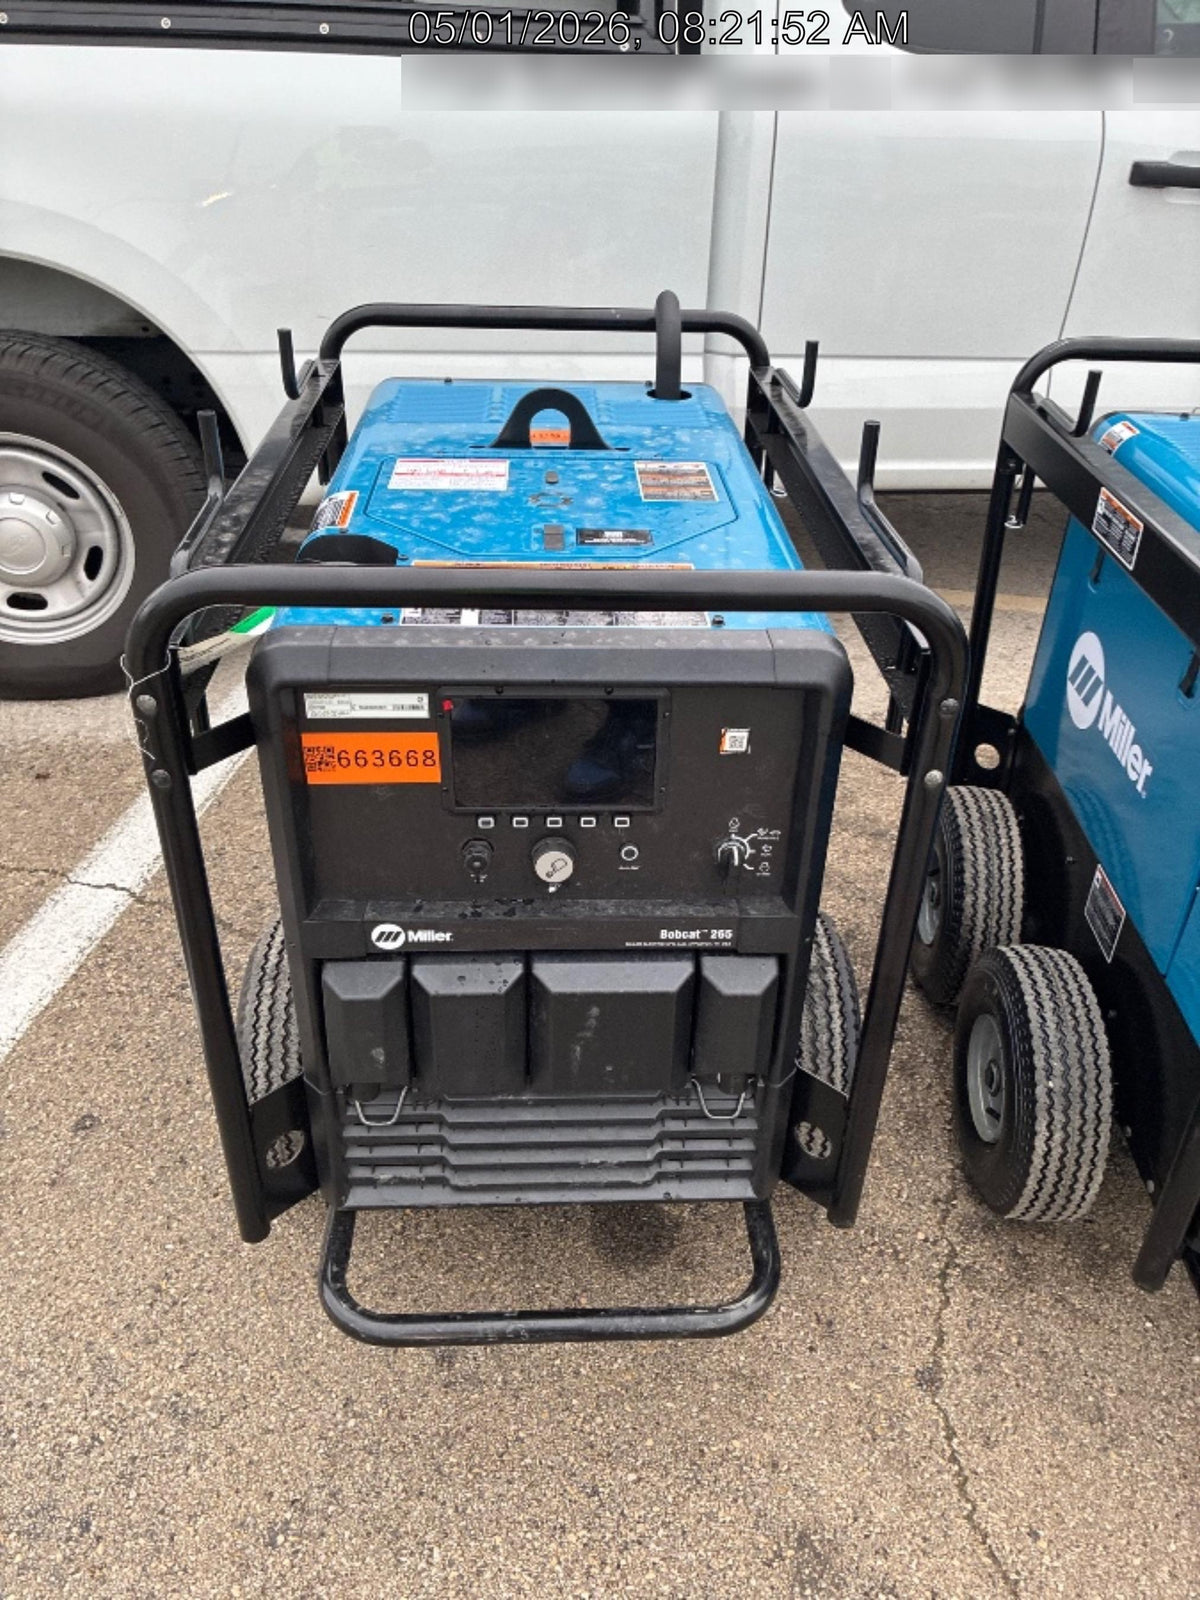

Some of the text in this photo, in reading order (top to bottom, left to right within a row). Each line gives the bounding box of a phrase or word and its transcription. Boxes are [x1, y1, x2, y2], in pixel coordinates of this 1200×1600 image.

[1098, 689, 1153, 793] Miller
[337, 749, 437, 769] 663668
[407, 929, 453, 943] Miller
[710, 929, 733, 940] 265
